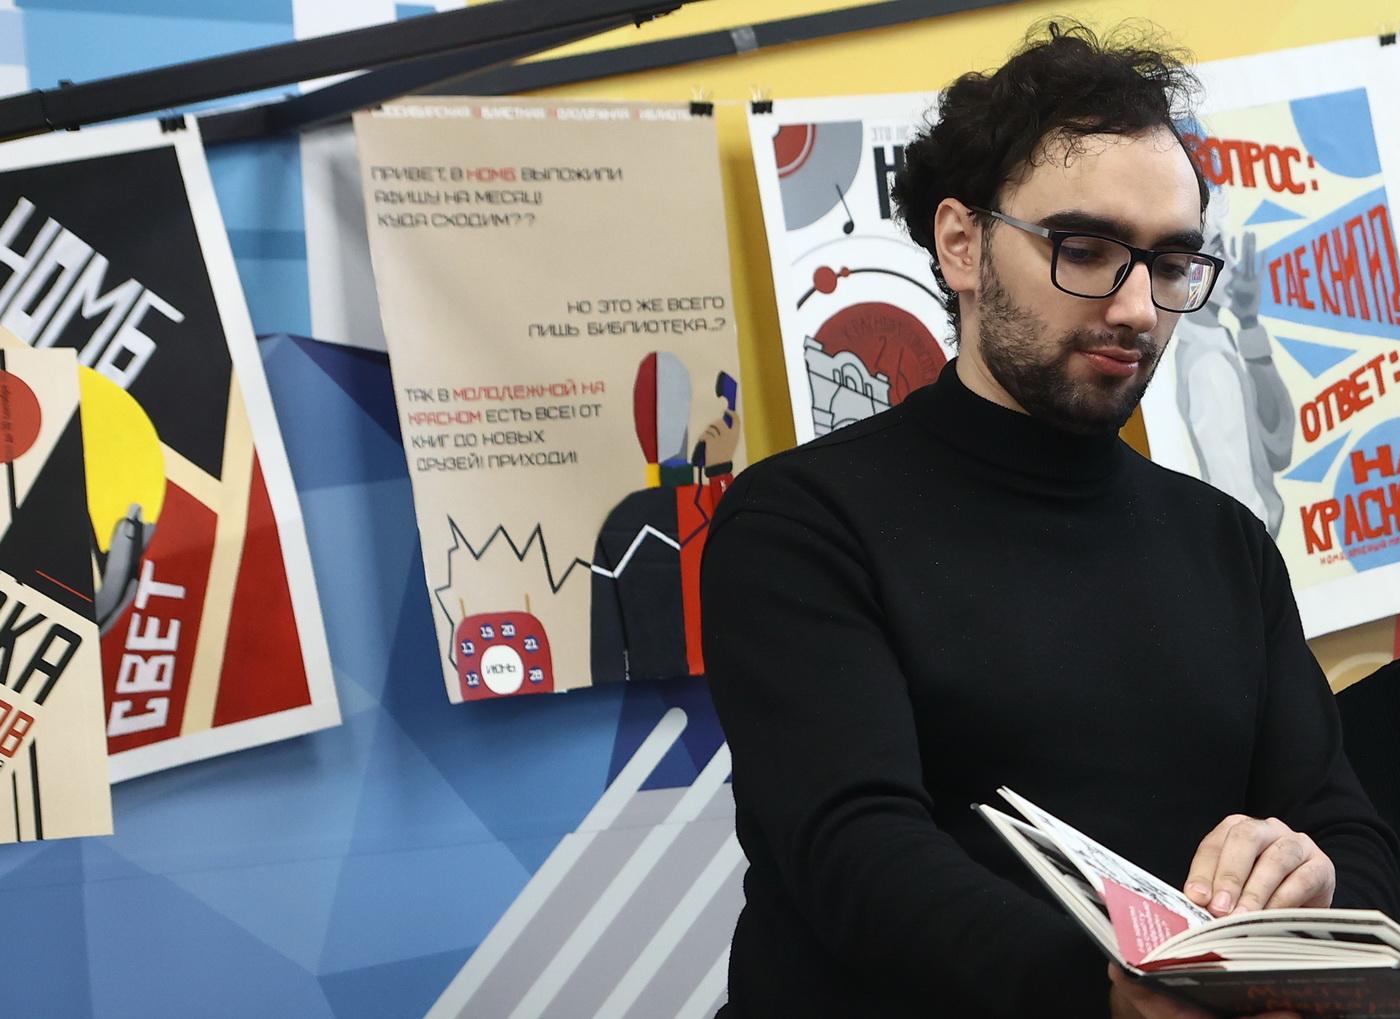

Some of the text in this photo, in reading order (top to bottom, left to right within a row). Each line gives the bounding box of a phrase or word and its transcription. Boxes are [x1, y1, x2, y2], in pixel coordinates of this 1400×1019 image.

[444, 189, 470, 205] НА
[1268, 246, 1316, 310] ГДЕ
[0, 195, 186, 390] НОМБ
[567, 296, 725, 314] НО ЭТО ЖЕ ВСЕГО
[528, 323, 580, 338] ЛИШЬ
[404, 378, 606, 403] ТАК В МОЛОДЕЖНОЙ НА
[408, 410, 482, 426] КРАСНОМ
[486, 408, 532, 423] ЕСТЬ
[579, 403, 603, 418] ОТ
[411, 429, 546, 448] КНИГ ДО НОВЫХ
[107, 559, 186, 738] СВЕТ
[466, 674, 480, 686] 12
